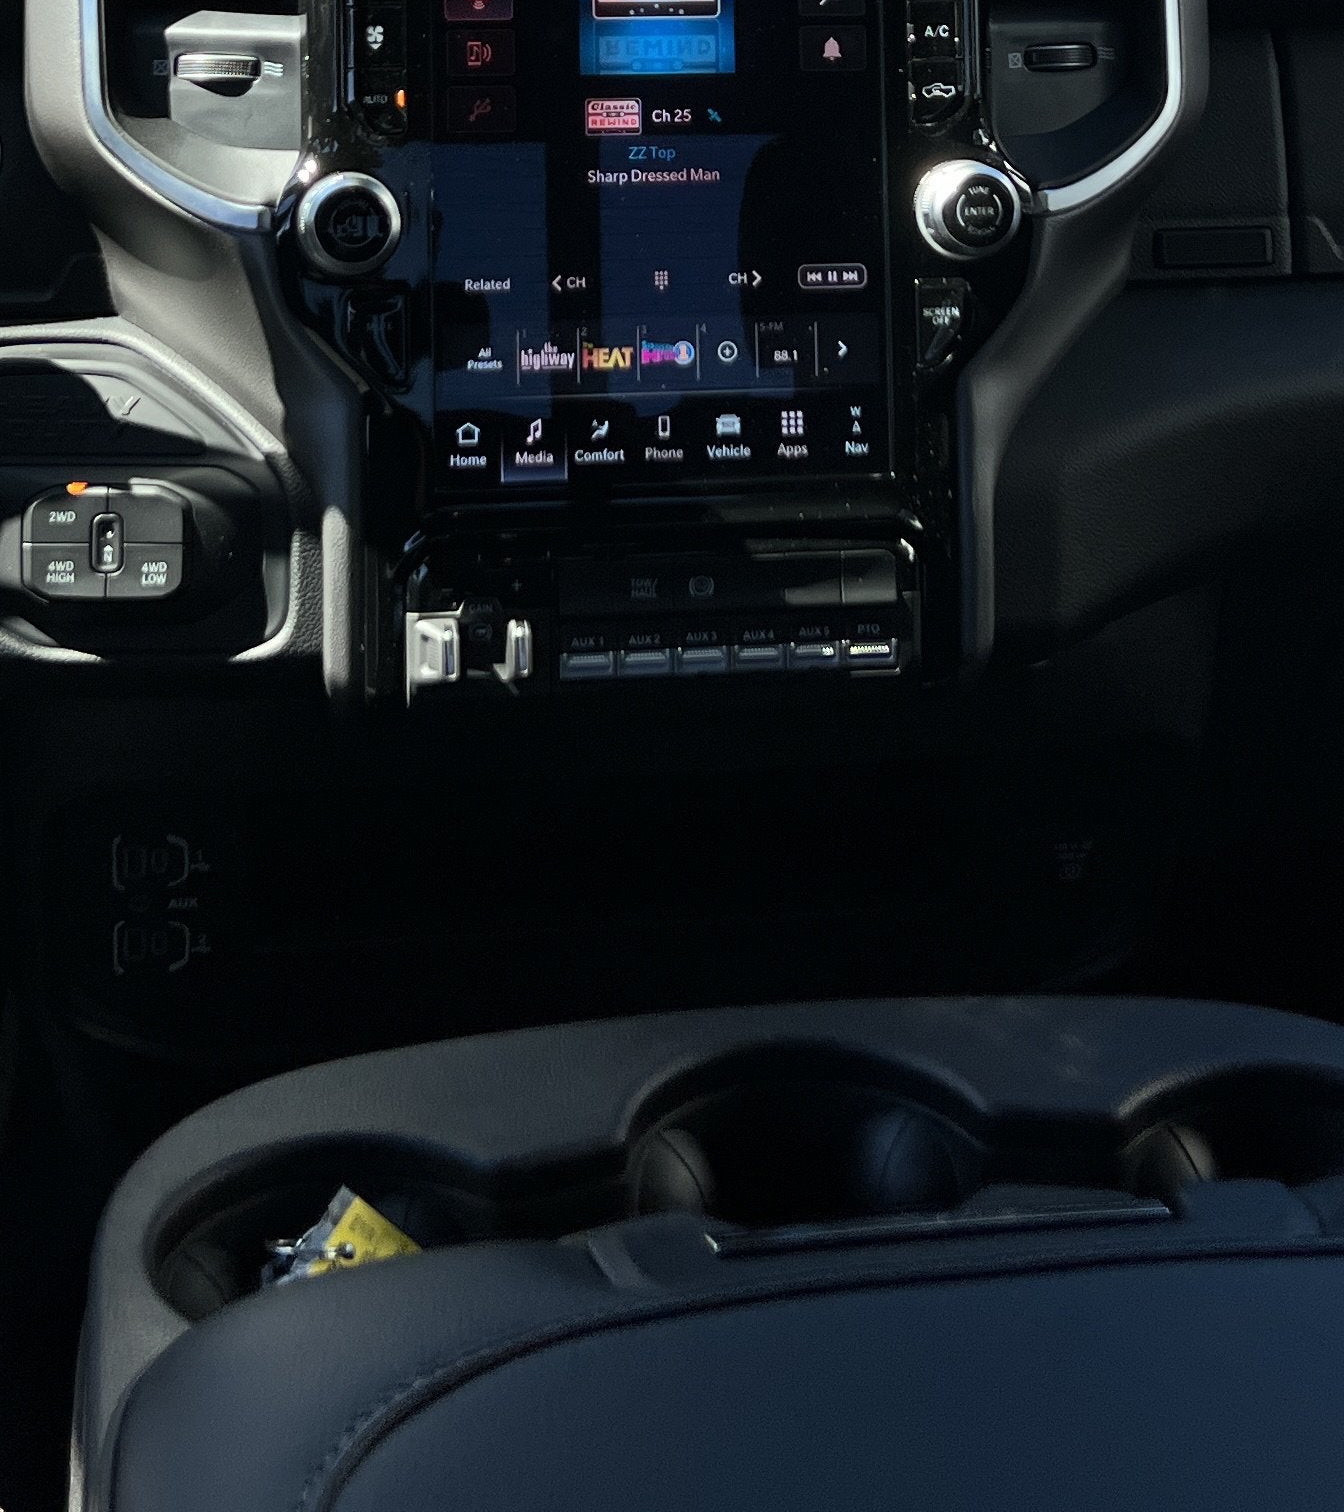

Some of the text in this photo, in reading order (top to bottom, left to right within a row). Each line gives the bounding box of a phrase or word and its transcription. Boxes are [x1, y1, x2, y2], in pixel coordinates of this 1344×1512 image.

[924, 25, 949, 37] A/C
[591, 102, 637, 112] Classic
[651, 108, 692, 123] Ch 25
[591, 118, 638, 127] REWIND
[628, 145, 676, 161] ZZ Top
[587, 167, 721, 186] Sharp Dressed Man
[964, 206, 995, 216] ENTER
[464, 277, 511, 291] Related
[566, 276, 587, 289] CH
[728, 272, 748, 285] CH
[922, 305, 960, 318] SCREEN
[477, 347, 492, 358] All
[544, 341, 558, 353] the
[520, 348, 575, 370] highway
[582, 347, 634, 369] HEAT
[773, 349, 798, 361] 88.1
[466, 358, 503, 371] Presets
[645, 446, 684, 461] Phone
[706, 443, 751, 458] Vehicle
[777, 441, 808, 458] Apps
[845, 440, 869, 455] Nav
[450, 454, 487, 467] Home
[515, 450, 554, 465] Media
[574, 447, 625, 463] Comfort
[48, 510, 76, 523] 2WD
[48, 560, 75, 572] 4WD
[140, 561, 167, 574] 4WD
[46, 571, 75, 584] HIGH
[140, 573, 167, 586] LOW
[686, 631, 707, 642] AUX
[743, 630, 765, 641] AUX
[798, 626, 820, 637] AUX
[571, 636, 593, 647] AUX
[628, 634, 650, 645] AUX
